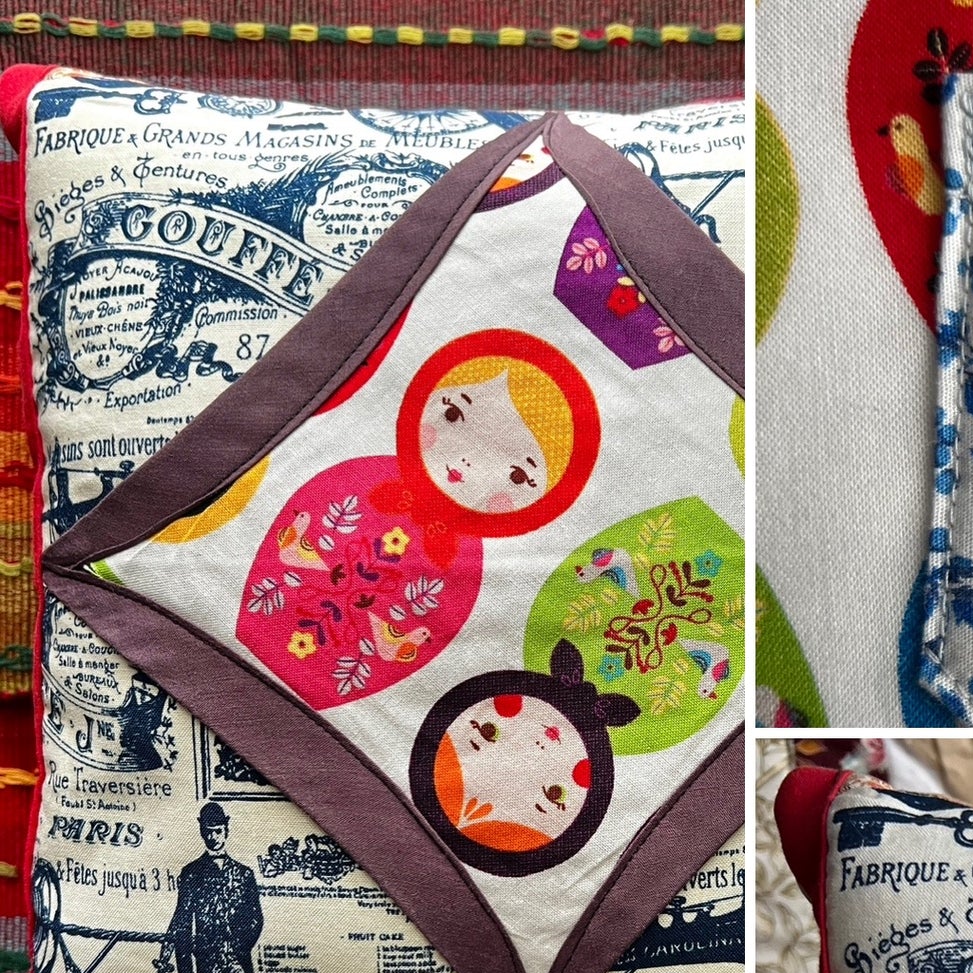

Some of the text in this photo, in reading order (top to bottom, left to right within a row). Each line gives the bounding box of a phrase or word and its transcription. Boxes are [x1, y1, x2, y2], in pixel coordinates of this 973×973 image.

[34, 127, 125, 158] FABRIQUE
[127, 134, 138, 148] &
[143, 122, 227, 148] GRANDS
[235, 131, 353, 149] MAGASINS
[359, 139, 376, 148] DE
[111, 165, 126, 188] &
[133, 152, 229, 189] Tentures
[195, 305, 278, 338] Commission
[236, 333, 270, 361] 87
[103, 382, 182, 412] Exportation
[87, 433, 115, 458] sont
[48, 760, 172, 797] Rue Traversière
[48, 814, 144, 848] PARIS
[152, 868, 161, 892] 3
[840, 856, 950, 893] FABRIQUE
[953, 869, 969, 888] &
[939, 906, 960, 935] &
